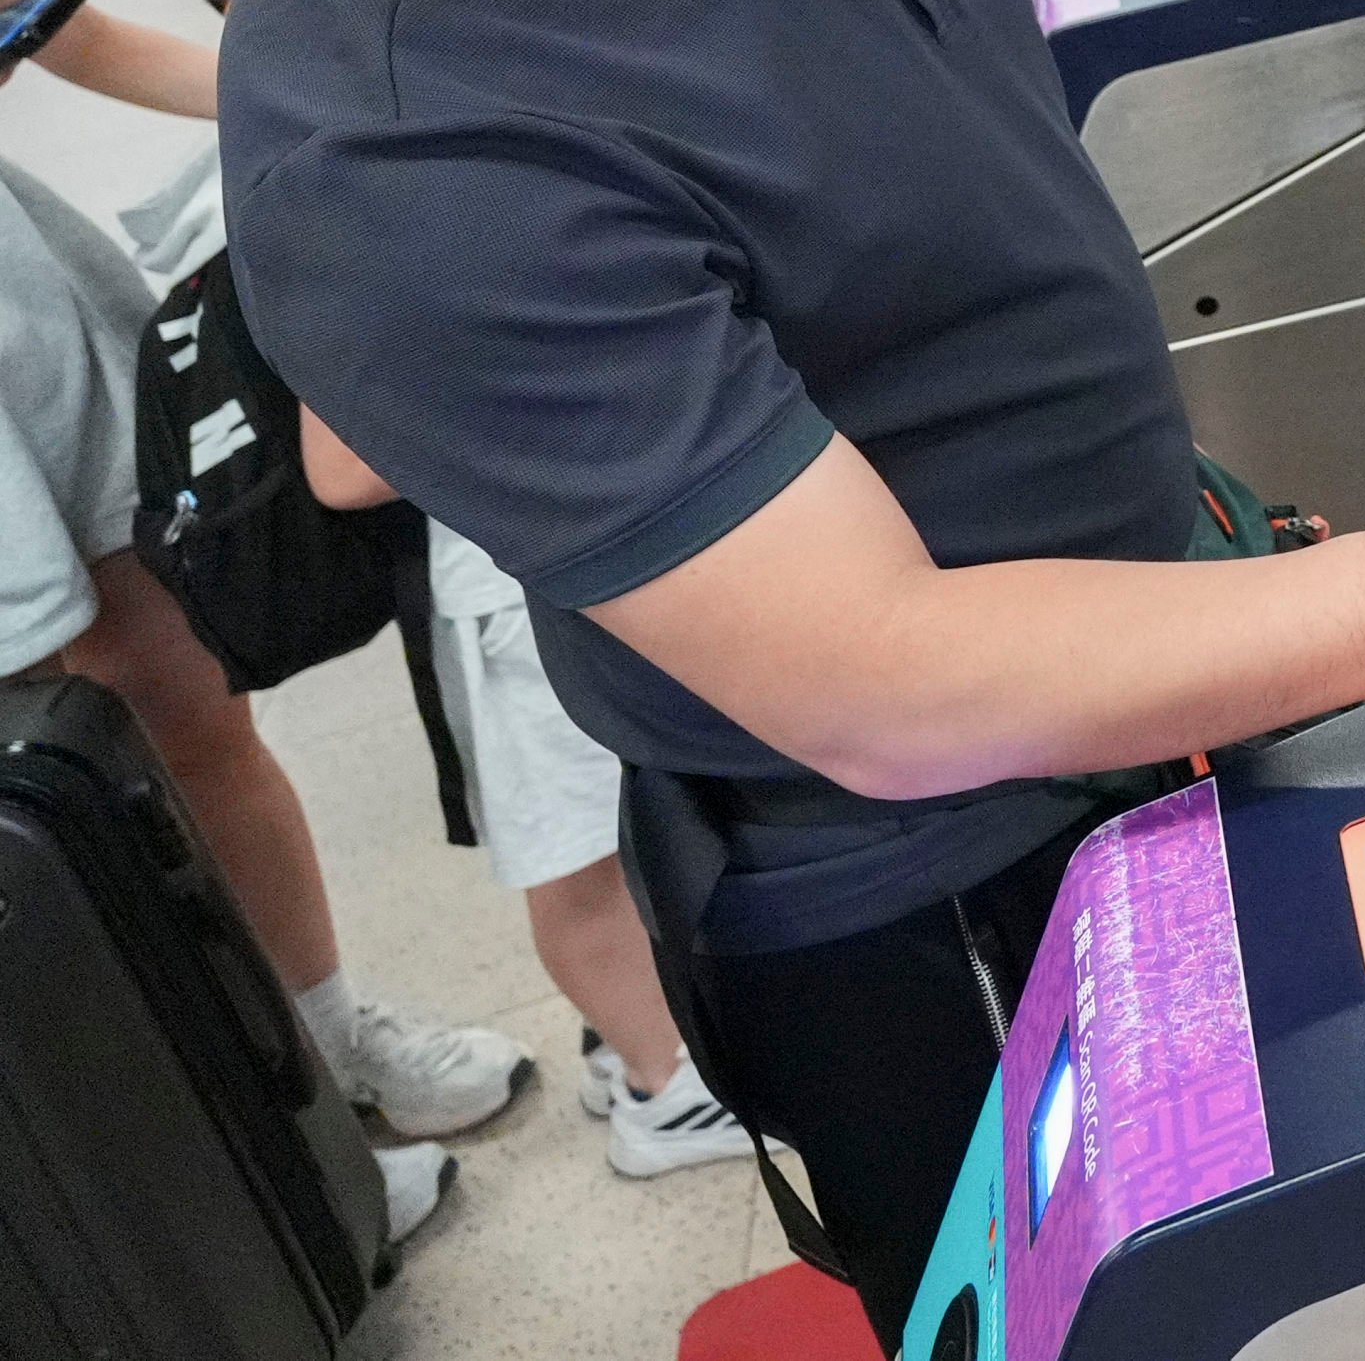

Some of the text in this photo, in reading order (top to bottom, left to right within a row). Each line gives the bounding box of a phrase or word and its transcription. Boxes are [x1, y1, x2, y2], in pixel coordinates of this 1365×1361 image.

[1079, 1030, 1094, 1087] Scan
[1081, 1080, 1098, 1125] QR
[1083, 1117, 1101, 1184] Code
